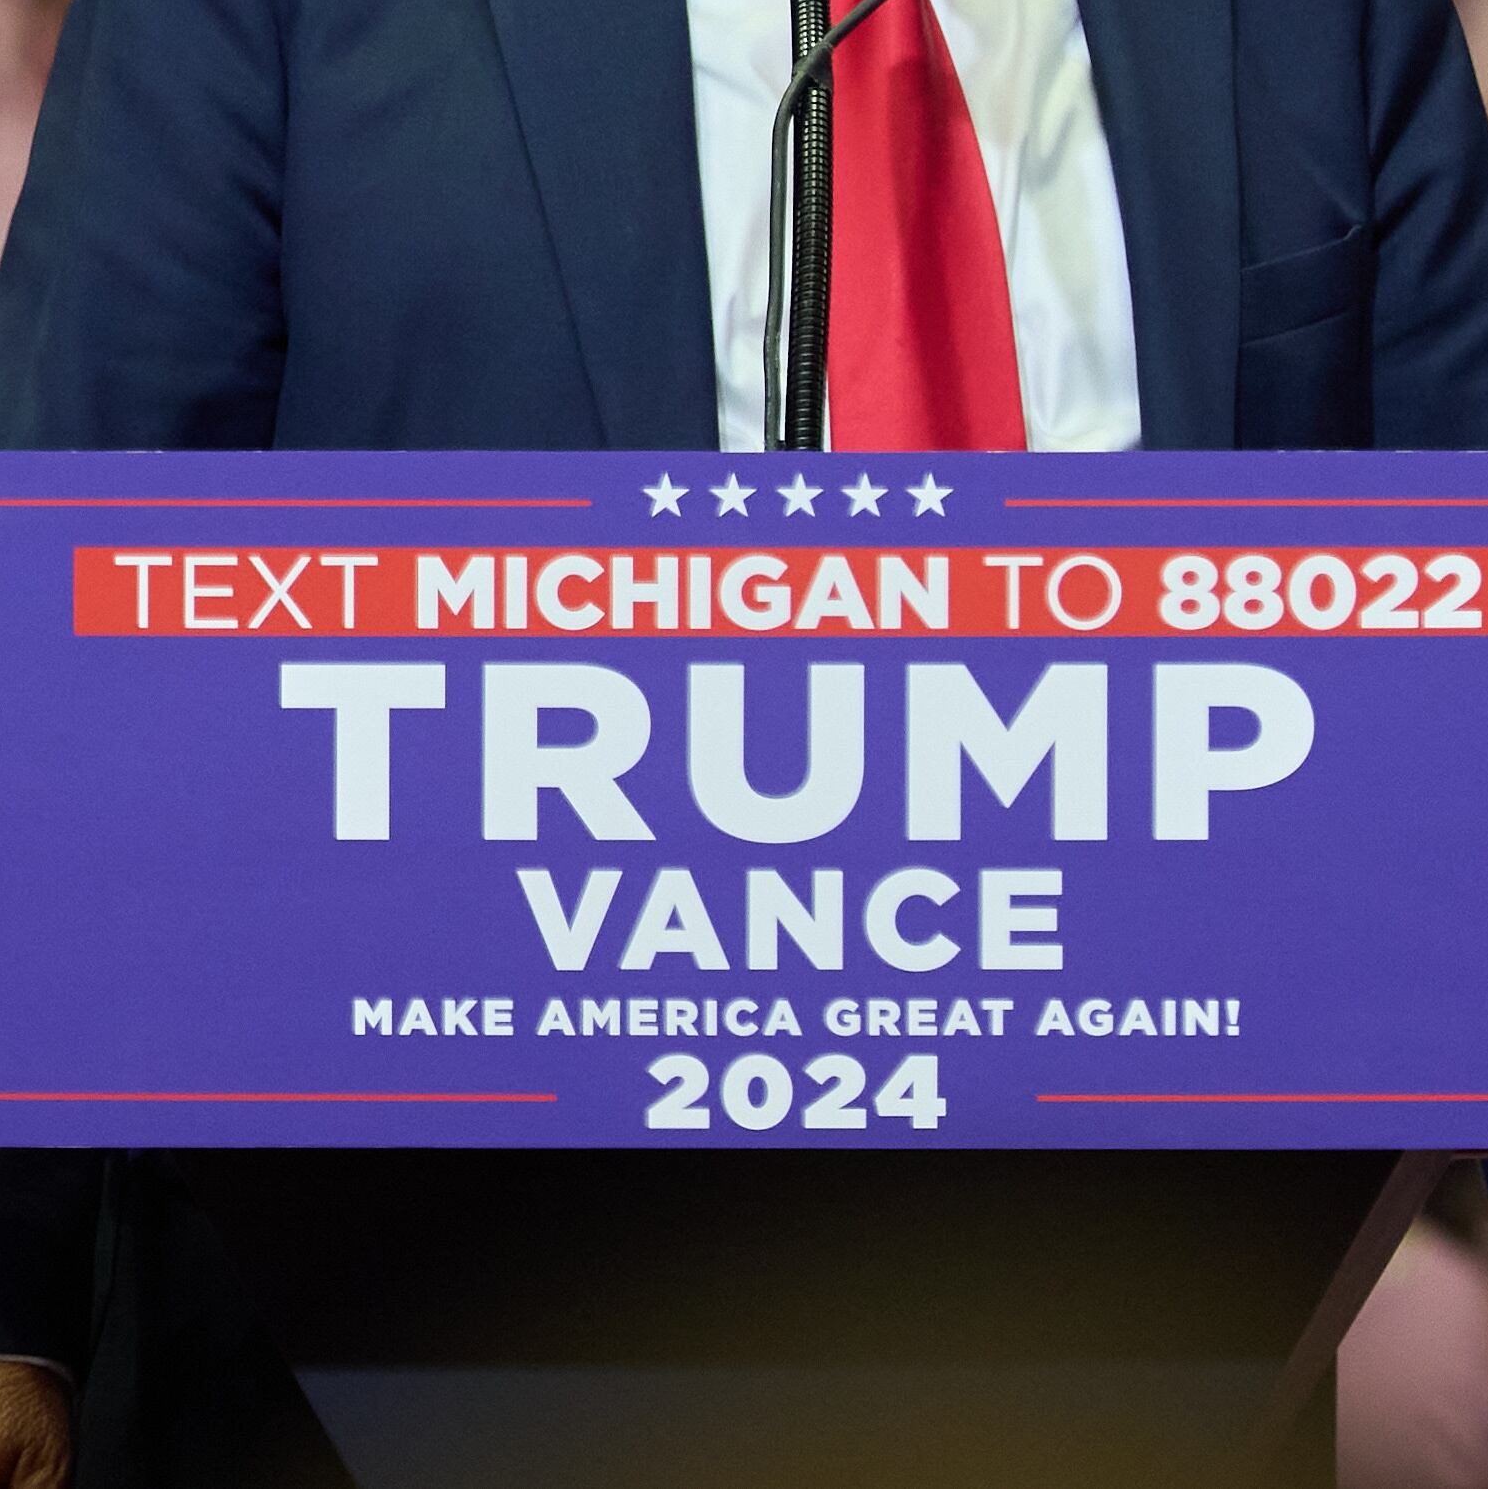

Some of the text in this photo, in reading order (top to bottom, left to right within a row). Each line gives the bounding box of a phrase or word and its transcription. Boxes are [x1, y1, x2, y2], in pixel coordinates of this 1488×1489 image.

[113, 553, 1483, 631] TEXT MICHIGAN TO 88022
[279, 660, 1316, 842] TRUMP
[516, 866, 1064, 973] VANCE
[353, 997, 1241, 1038] MAKE AMERICA GREAT AGAIN!
[645, 1052, 948, 1132] 2024
